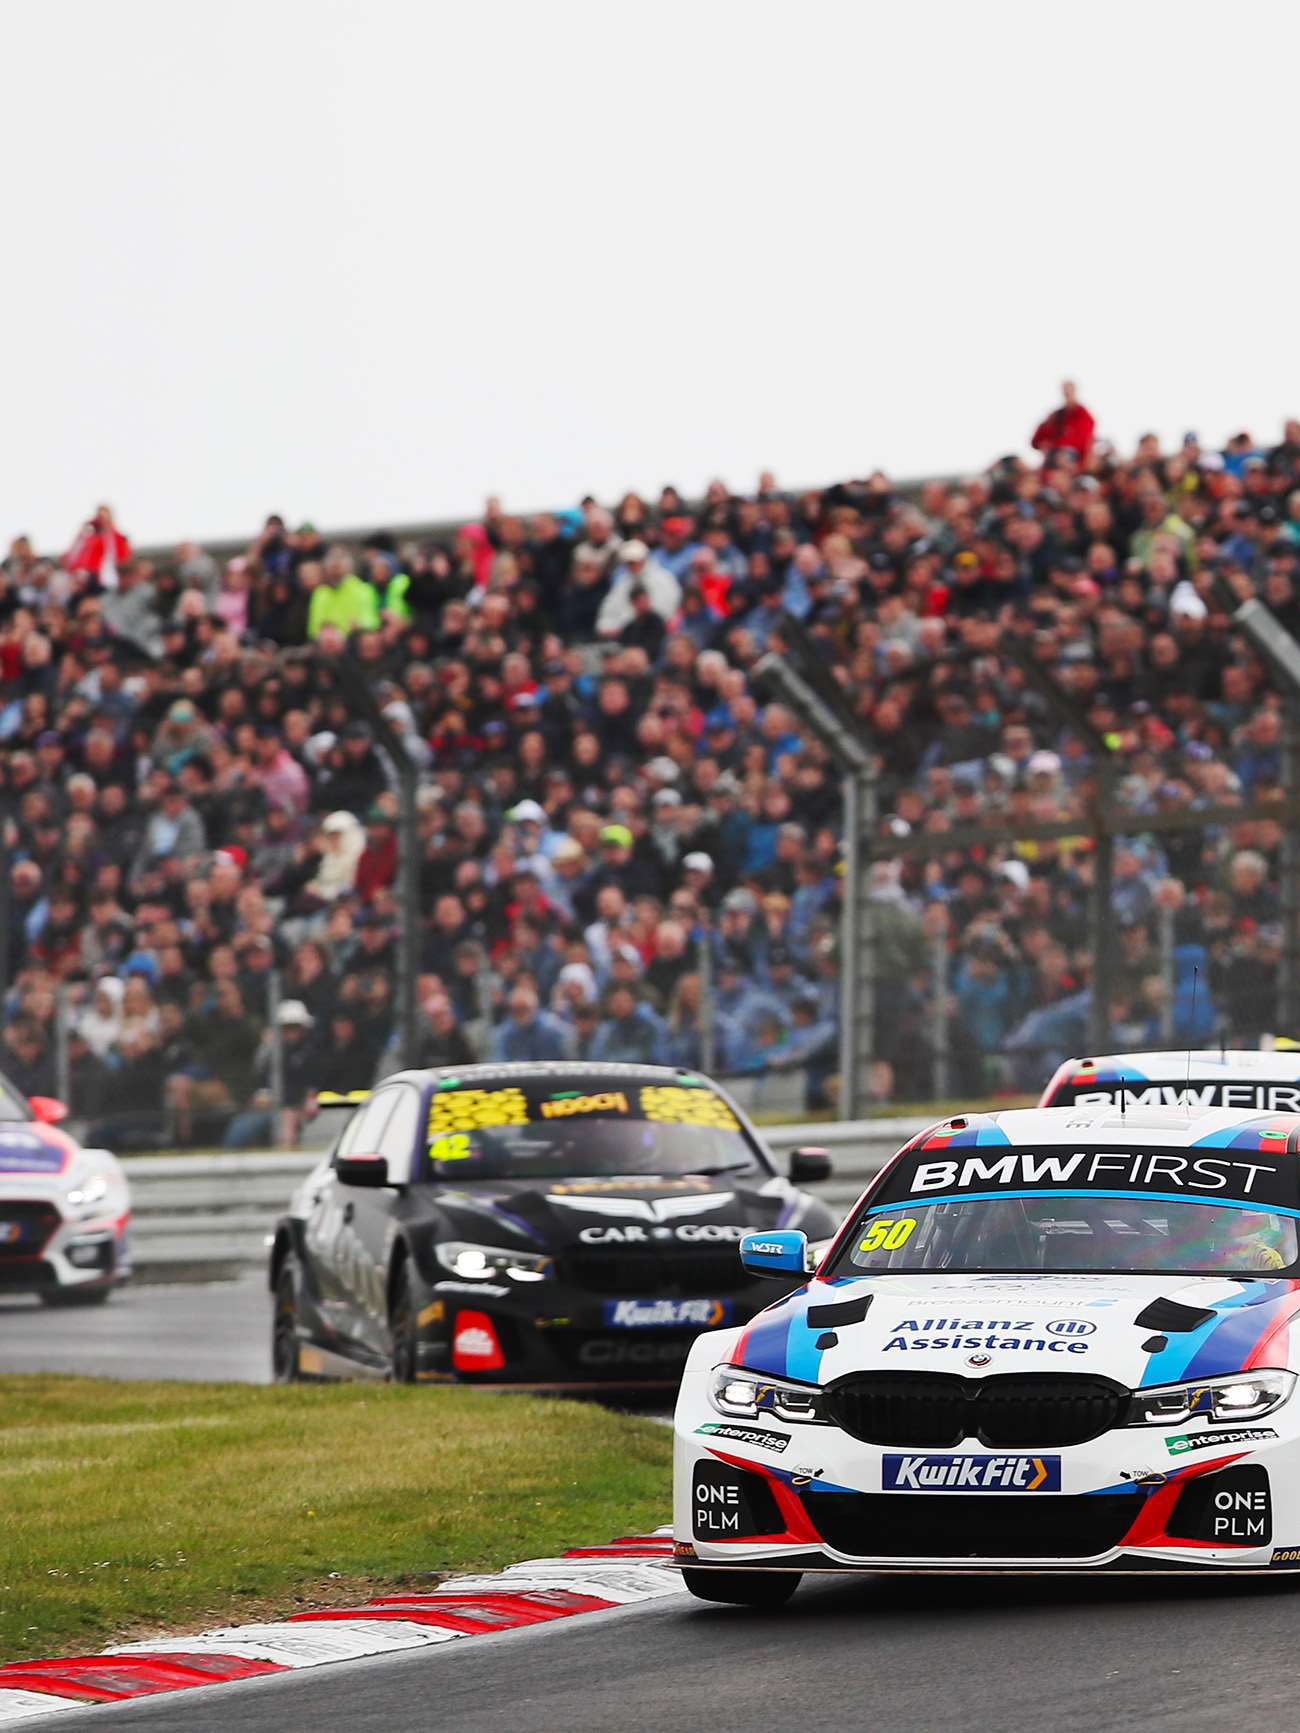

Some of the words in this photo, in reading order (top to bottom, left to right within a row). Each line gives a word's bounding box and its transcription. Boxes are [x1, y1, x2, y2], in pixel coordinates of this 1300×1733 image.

[428, 1133, 472, 1161] 42
[579, 1226, 648, 1245] CAR
[859, 1218, 917, 1251] 50
[751, 1242, 785, 1255] WSR
[891, 1317, 1035, 1334] Allianz
[882, 1333, 1090, 1354] Assistance
[703, 1425, 787, 1449] enterprise
[1173, 1430, 1277, 1450] enterprise
[696, 1483, 740, 1505] ONE
[1214, 1491, 1267, 1510] ONE
[697, 1509, 739, 1530] PLM
[1214, 1517, 1265, 1536] PLM
